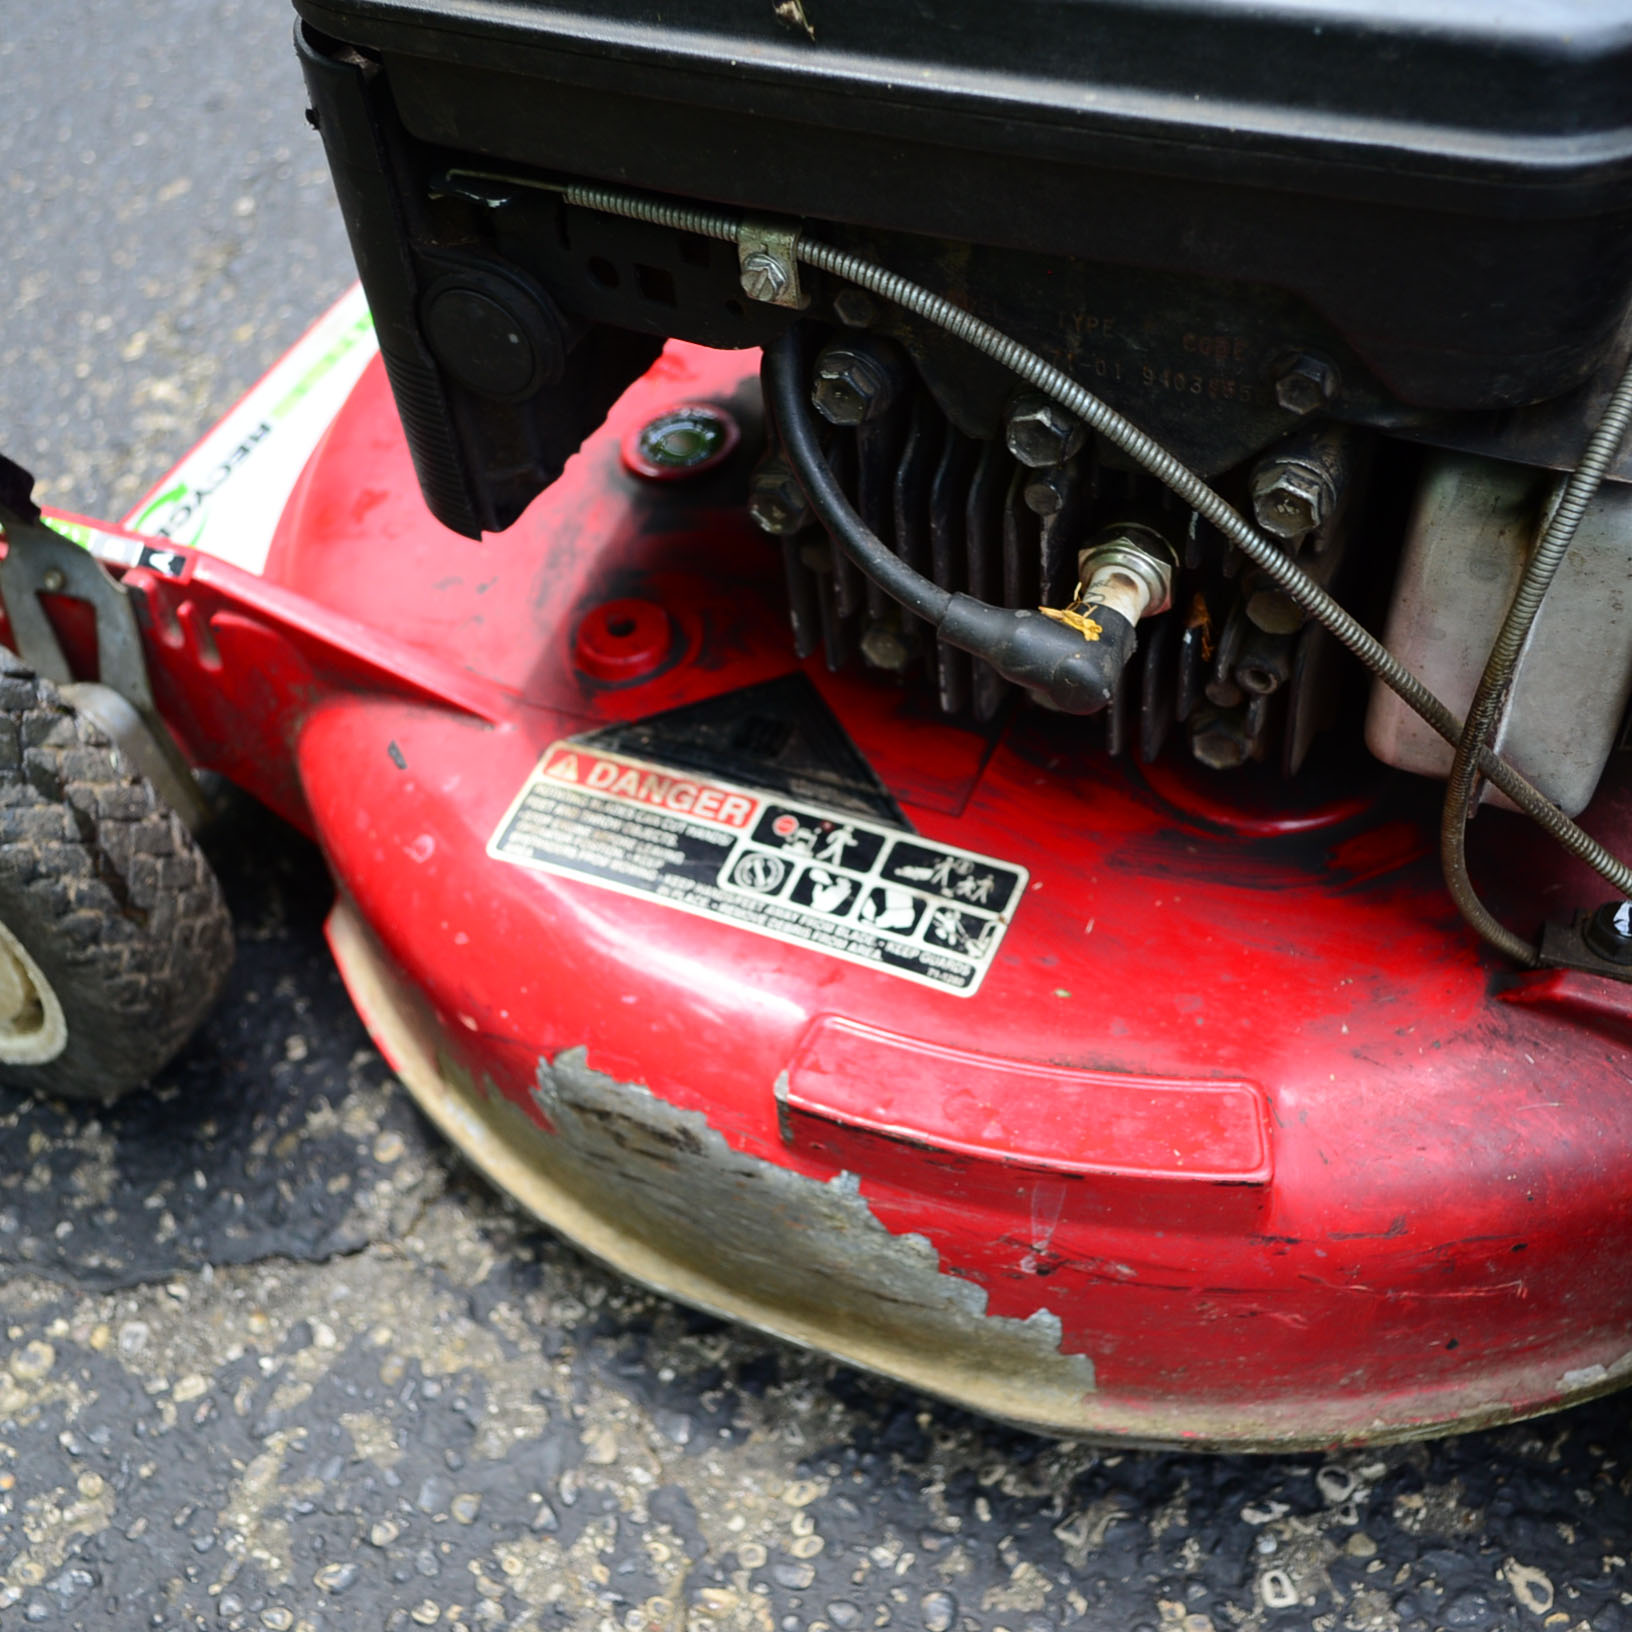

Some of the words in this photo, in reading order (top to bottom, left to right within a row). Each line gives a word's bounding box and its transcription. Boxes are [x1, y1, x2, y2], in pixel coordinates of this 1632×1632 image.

[1057, 310, 1117, 339] TYPE
[585, 759, 755, 827] DANGER
[883, 941, 920, 960] KEEP
[917, 951, 973, 977] GUARDS
